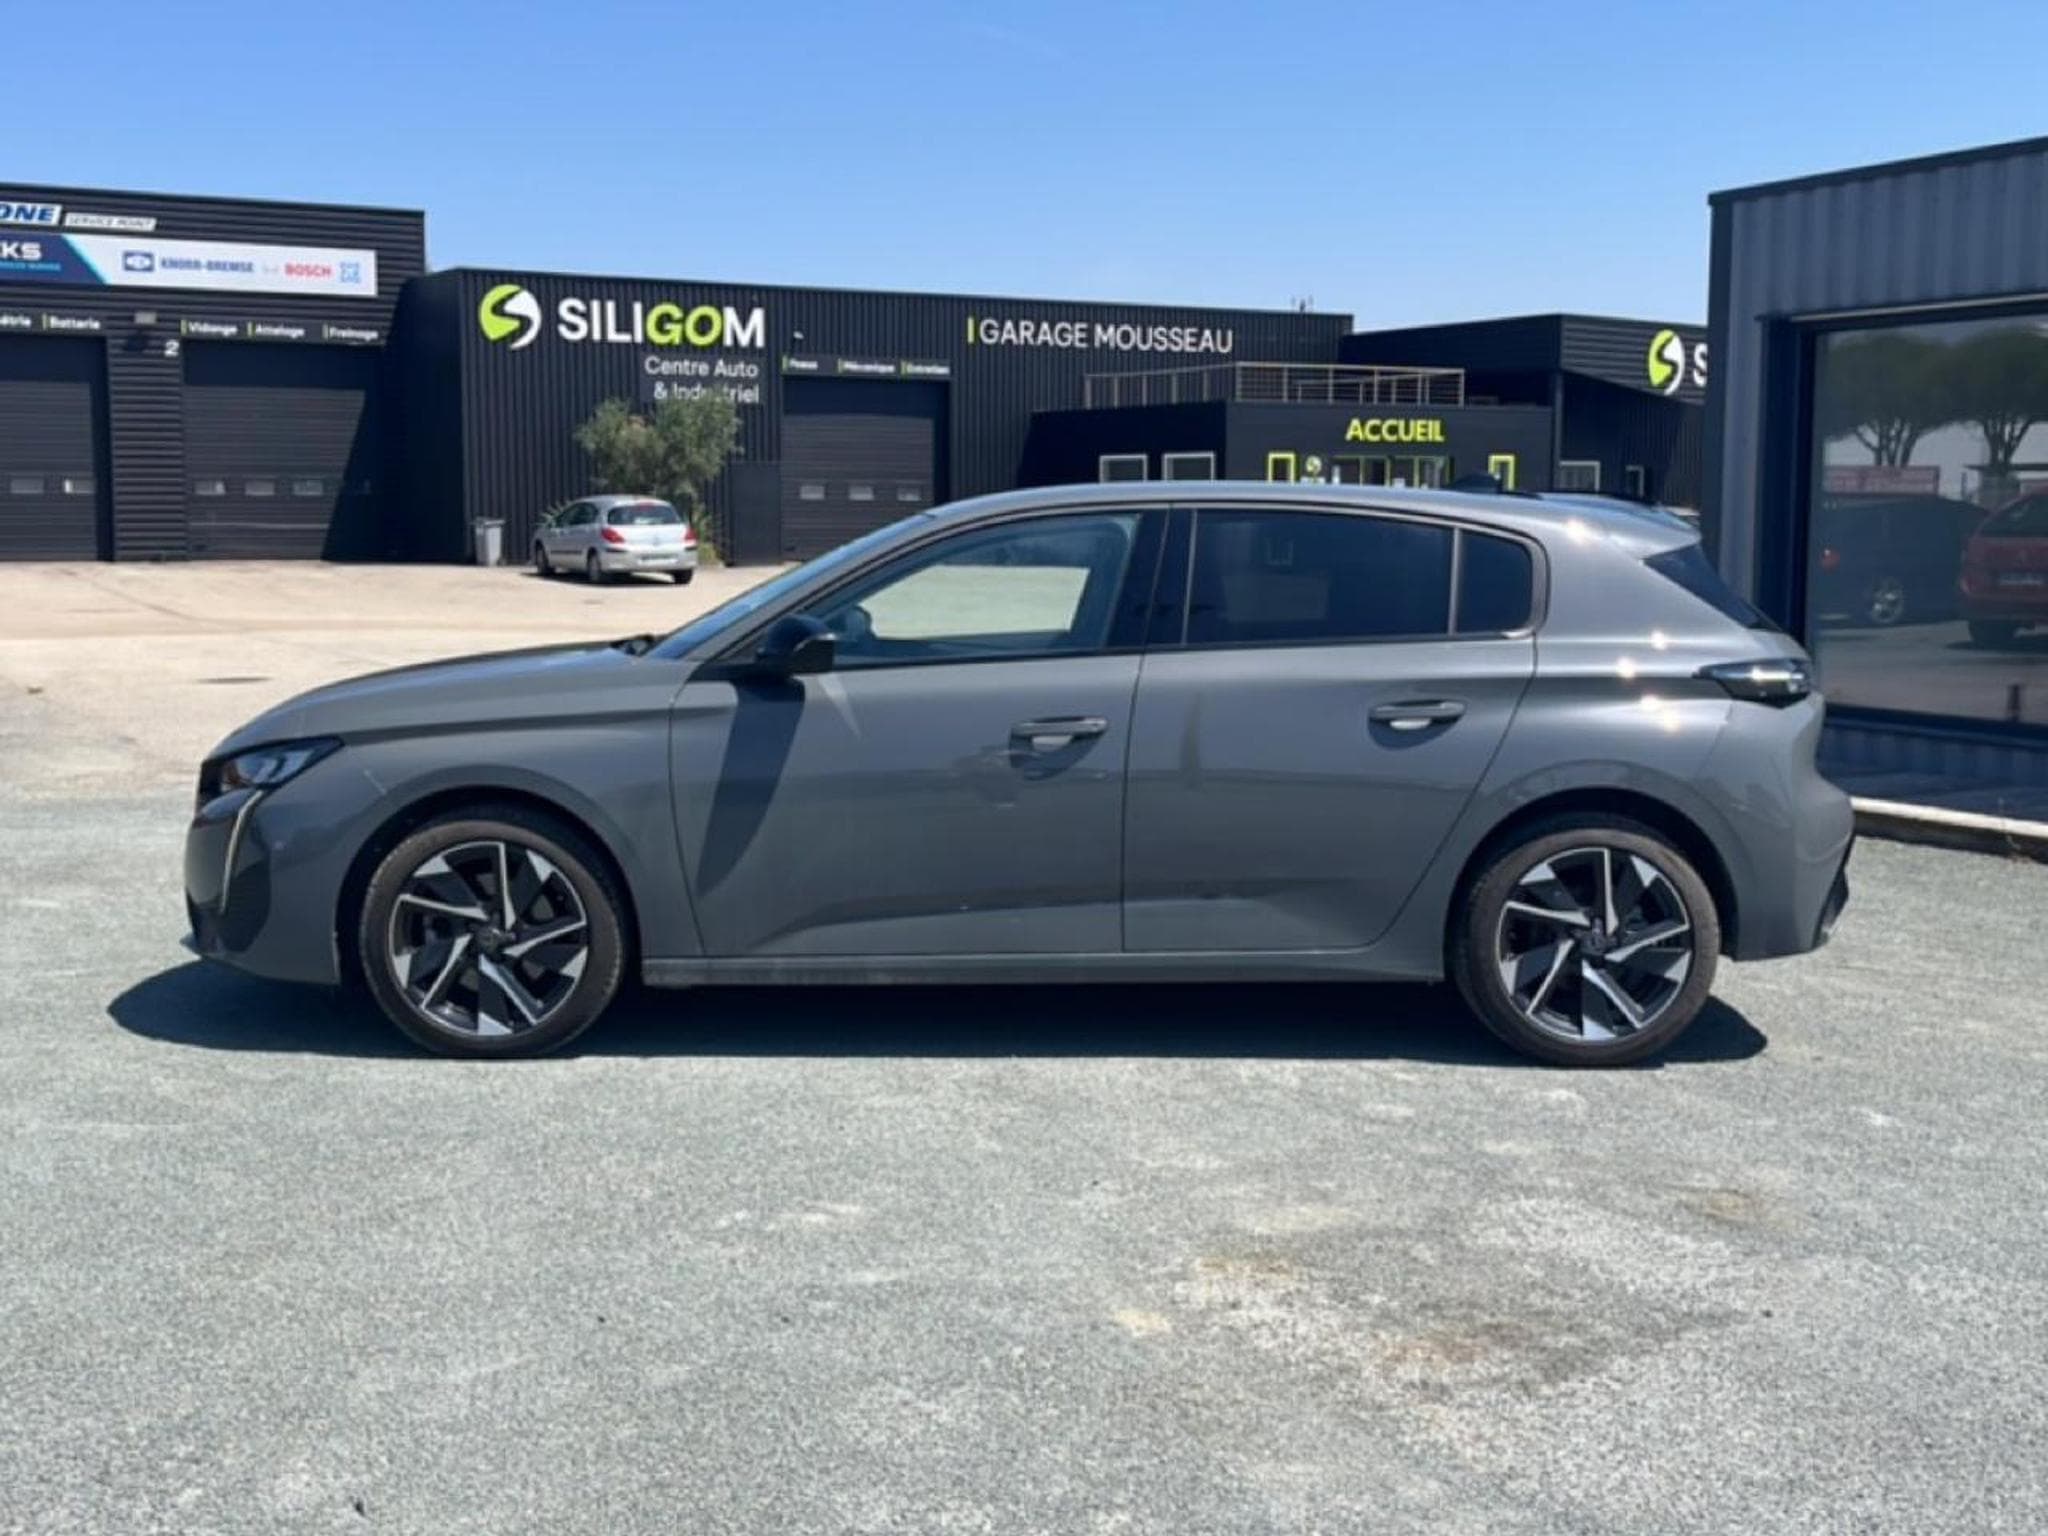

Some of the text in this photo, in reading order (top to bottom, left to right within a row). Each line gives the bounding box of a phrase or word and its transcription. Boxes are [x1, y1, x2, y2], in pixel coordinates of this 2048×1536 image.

[0, 203, 55, 221] ONE
[285, 261, 332, 278] BOSCH
[557, 297, 765, 348] SILIGOM
[979, 319, 1233, 354] GARAGE MOUSSEAU
[164, 339, 180, 357] 2
[644, 355, 759, 378] Centre Auto
[654, 381, 668, 400] &
[1345, 418, 1445, 442] ACCUEIL
